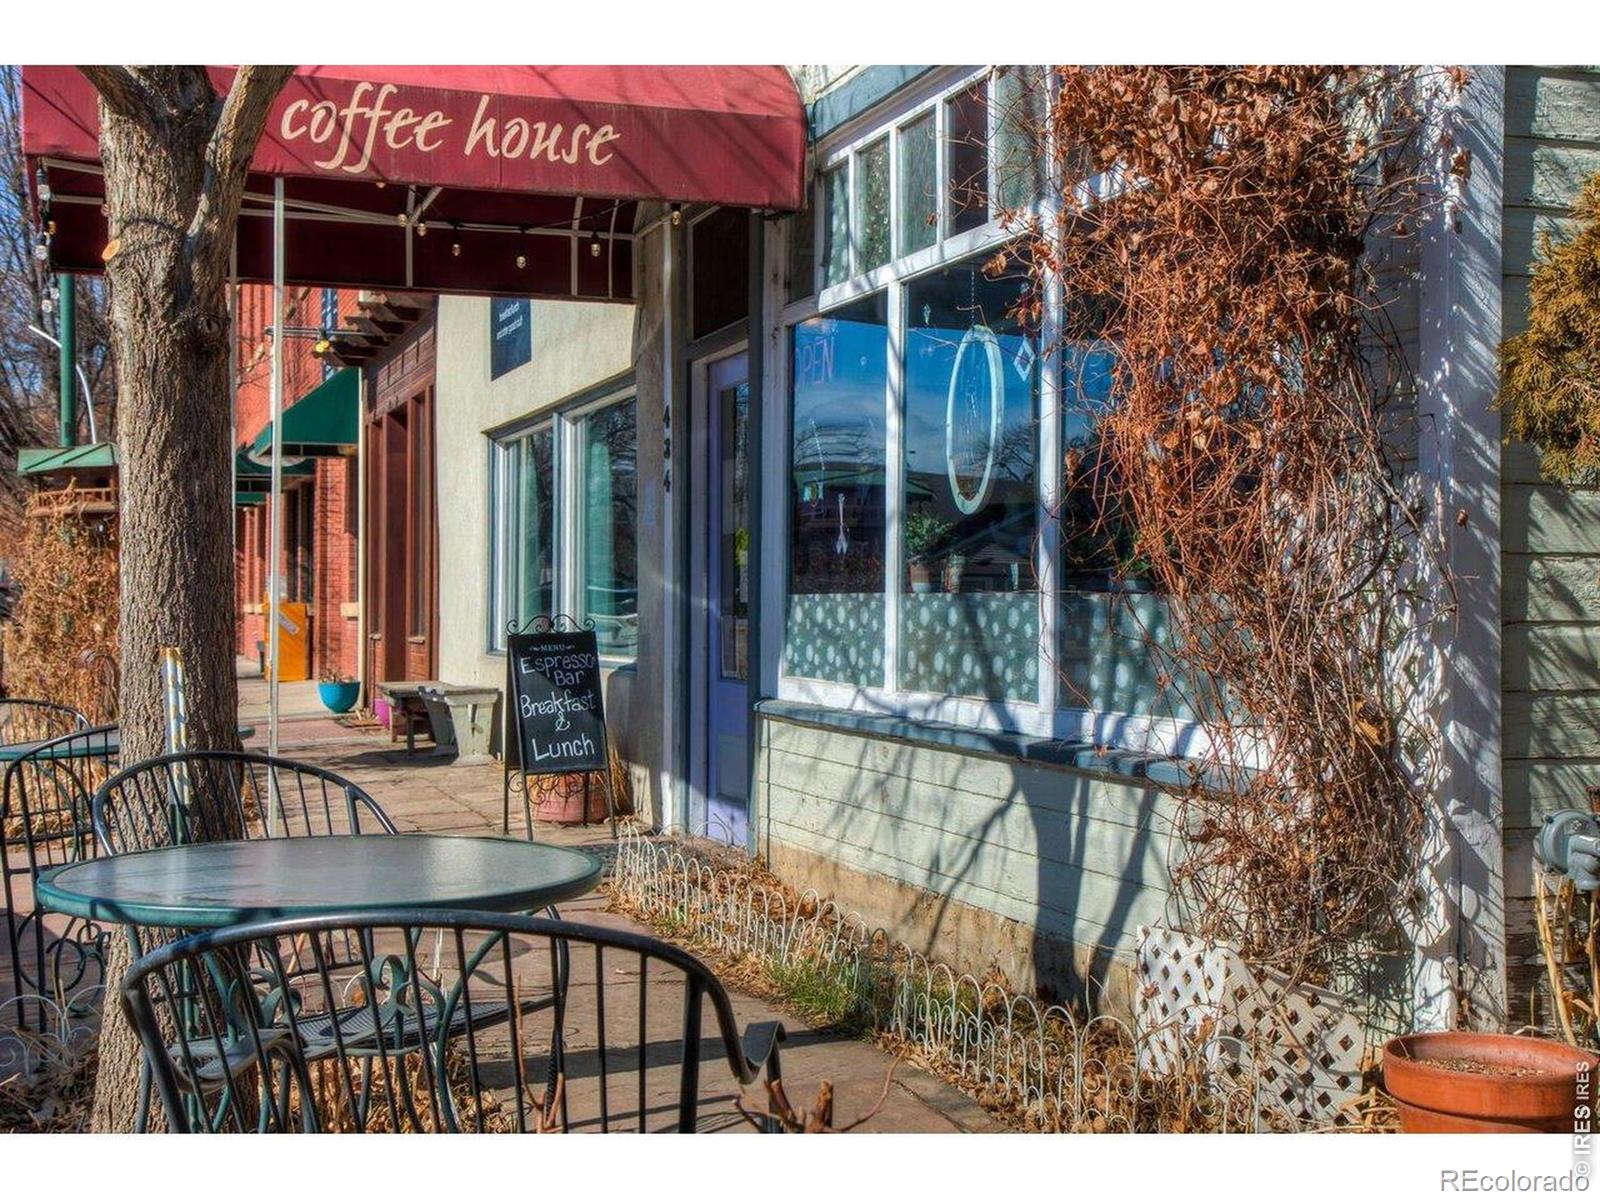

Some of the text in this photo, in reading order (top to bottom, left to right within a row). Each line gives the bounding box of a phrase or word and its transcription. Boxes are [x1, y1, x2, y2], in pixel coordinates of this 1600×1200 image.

[280, 81, 621, 174] coffee house
[541, 644, 565, 652] MENU
[520, 653, 596, 678] Espresso
[553, 669, 585, 686] Bar
[520, 689, 596, 718] Breakfast
[532, 733, 595, 761] Lunch
